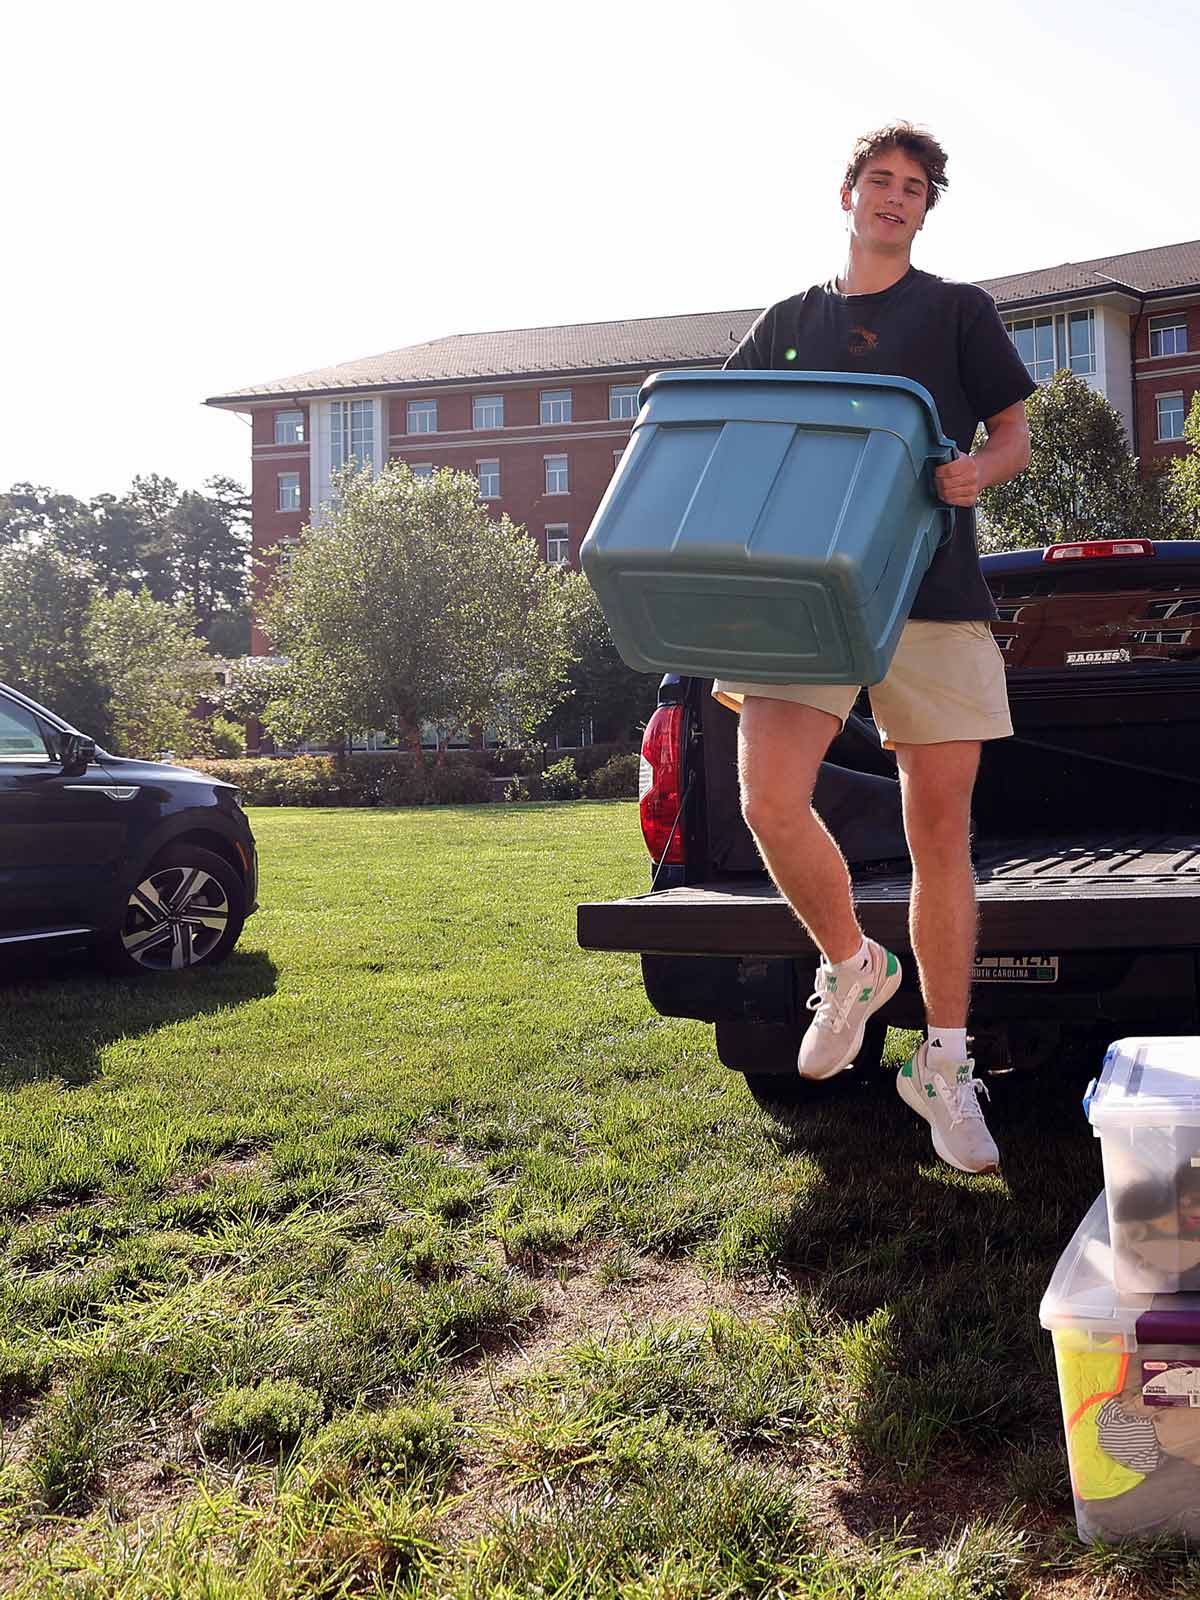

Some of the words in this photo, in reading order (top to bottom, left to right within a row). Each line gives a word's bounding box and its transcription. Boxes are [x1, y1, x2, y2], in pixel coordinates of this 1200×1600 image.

[1066, 652, 1121, 663] EAGLES
[970, 967, 991, 978] OUTH
[992, 967, 1030, 978] CAROLINA
